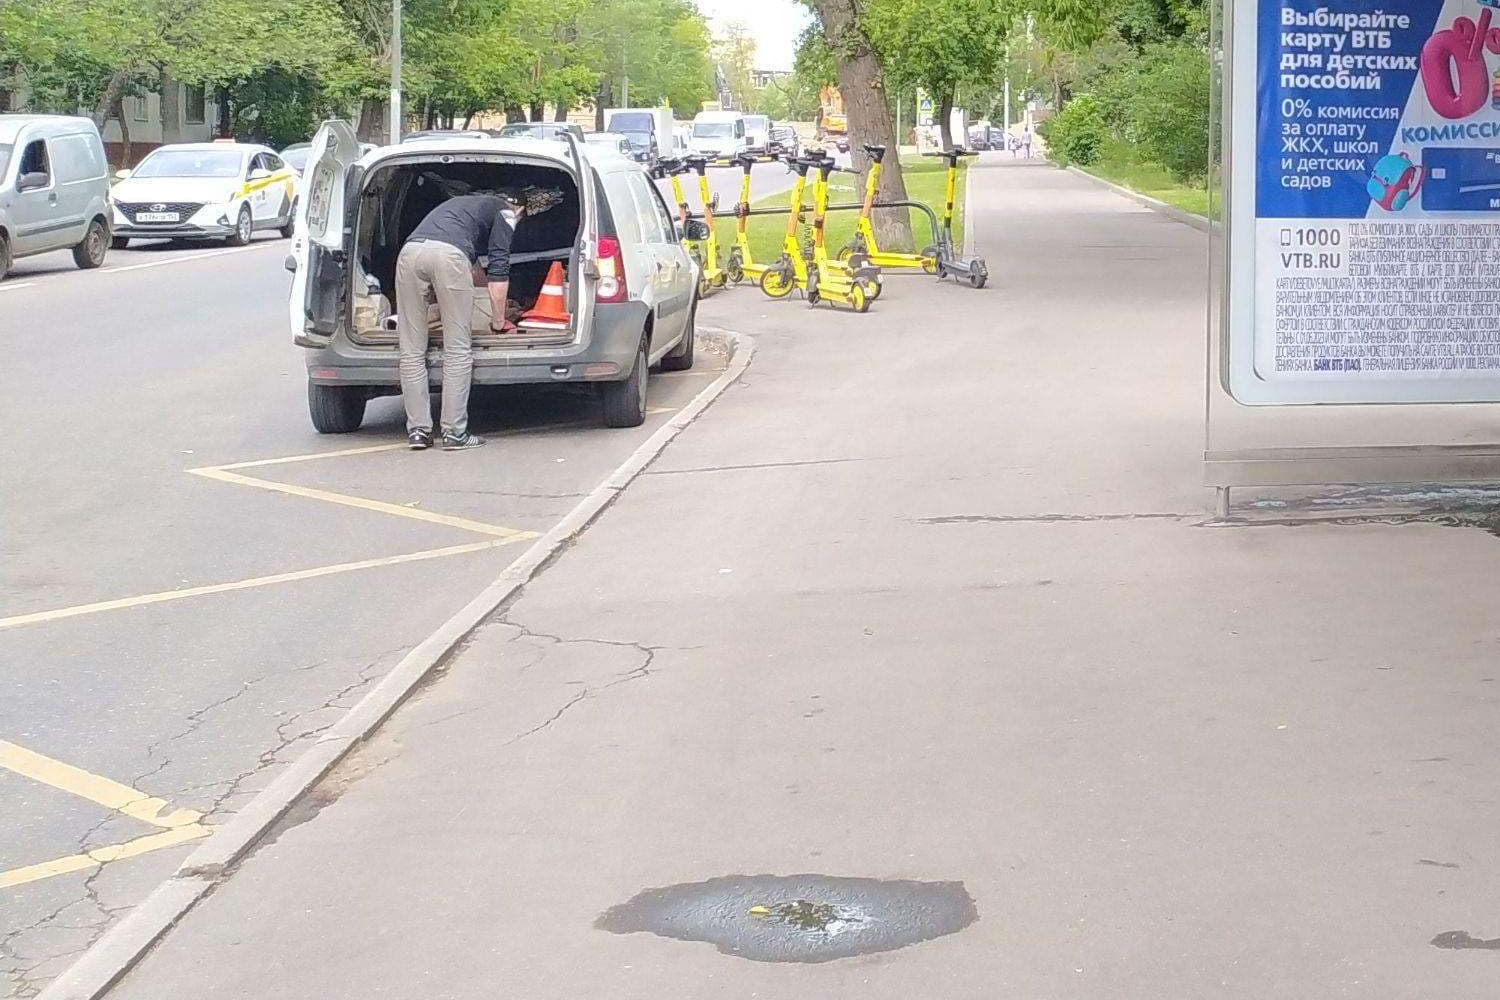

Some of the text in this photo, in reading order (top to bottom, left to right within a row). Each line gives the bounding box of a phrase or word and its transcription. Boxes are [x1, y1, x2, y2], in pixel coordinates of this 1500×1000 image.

[1281, 7, 1410, 29] Выбирайте
[1281, 30, 1392, 52] карту ВТБ
[1280, 52, 1417, 74] для детских
[1280, 69, 1381, 90] пособий
[1281, 99, 1399, 120] 0% комиссия
[1281, 123, 1366, 138] за оплату
[1281, 136, 1379, 155] ЖКХ, школ
[1281, 156, 1366, 172] и детских
[1281, 174, 1331, 189] садов
[1296, 228, 1341, 247] 1000
[1280, 252, 1341, 269] VTB.RU
